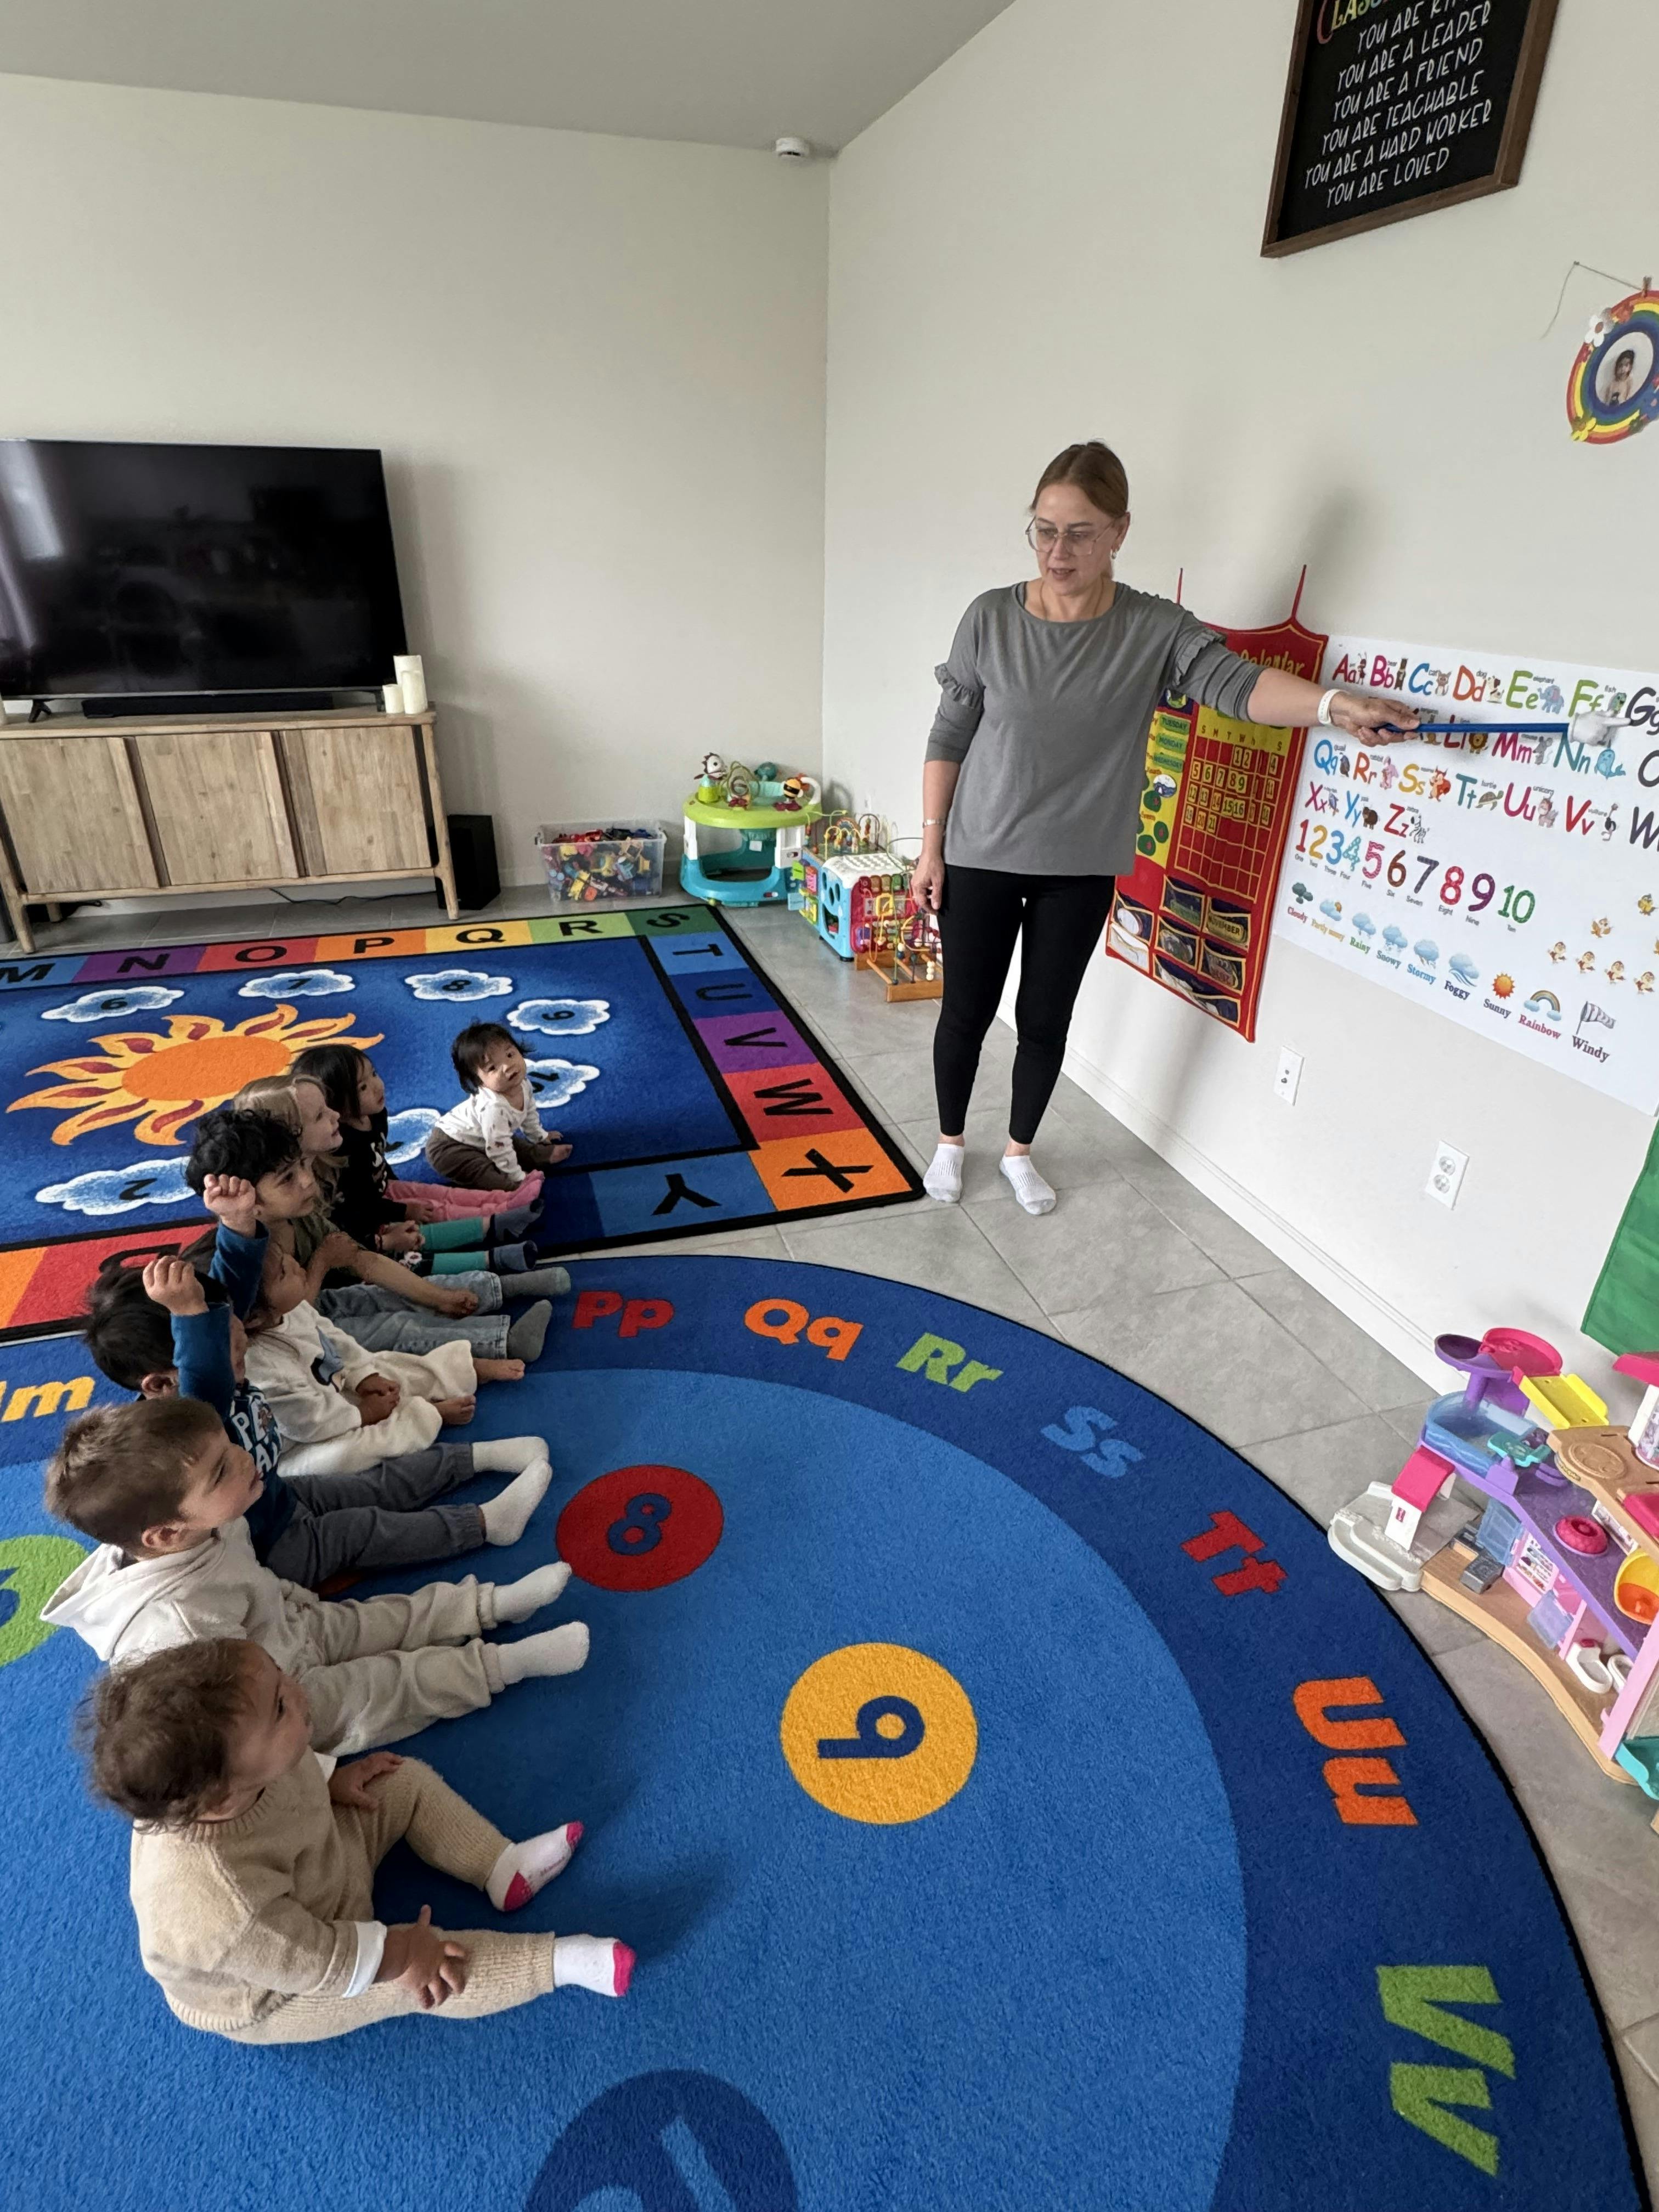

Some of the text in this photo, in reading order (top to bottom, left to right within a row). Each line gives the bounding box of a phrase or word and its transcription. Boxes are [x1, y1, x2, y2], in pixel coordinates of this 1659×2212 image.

[1338, 0, 1491, 92] YOU ARE A LEADER
[1357, 19, 1388, 54] YOU
[1391, 1, 1425, 38] ARE
[1334, 38, 1483, 122] YOU ARE A FRIEND
[1322, 70, 1485, 155] YOU ARE TEACHABLE
[1305, 99, 1492, 189] YOU ARE A HARD WORKER
[1327, 147, 1449, 208] YOU ARE LOVED
[1332, 653, 1357, 684] Aa
[1370, 654, 1394, 689] Bb
[1408, 663, 1434, 696] Cc
[1453, 664, 1487, 702] Dd
[1506, 670, 1538, 709] Ee
[1605, 685, 1616, 693] fish
[1159, 735, 1183, 749] MONDAY
[1162, 717, 1188, 729] TUESDAY
[1201, 725, 1206, 734] S
[1213, 728, 1218, 738] M
[1227, 731, 1232, 740] T
[1239, 733, 1246, 743] W
[1277, 741, 1283, 752] S
[1193, 764, 1199, 777] 5
[1205, 766, 1211, 781] 6
[1218, 770, 1224, 785] 7
[1229, 773, 1237, 787] 8
[1238, 776, 1245, 791] 9
[1235, 748, 1241, 764] 1
[1243, 752, 1250, 766] 2
[1492, 732, 1532, 764] Mm
[1553, 732, 1590, 774] Nn
[1223, 799, 1233, 813] 15
[1233, 802, 1244, 816] 16
[1305, 781, 1328, 814] Xx
[1345, 790, 1362, 828] Yy
[1384, 803, 1409, 838] Zz
[1314, 739, 1339, 776] Qq
[1353, 752, 1377, 785] Rr
[1398, 763, 1425, 795] Ss
[1455, 773, 1477, 809] Tt
[1481, 780, 1497, 789] turtle
[1504, 782, 1536, 821] Uu
[1533, 786, 1555, 795] unicorn
[1566, 795, 1595, 836] Vv
[1296, 819, 1535, 924] 1 2 3 4 5 6 7 8 9 10
[1386, 889, 1396, 898] Six
[1406, 895, 1423, 907] Seven
[1438, 905, 1453, 916] Eight
[1465, 915, 1480, 926] Nine
[0, 912, 691, 983] M N O P Q R S
[673, 944, 723, 957] T
[101, 997, 128, 1011] 6
[286, 977, 314, 990] 7
[442, 979, 472, 992] 8
[696, 983, 754, 1002] U
[1288, 906, 1308, 923] Cloudy
[1350, 936, 1370, 954] Rainy
[1376, 950, 1402, 969] Snowy
[1407, 964, 1436, 985] Stormy
[1444, 980, 1470, 1000] Foggy
[1483, 998, 1512, 1019] Sunny
[1517, 1014, 1562, 1040] Rainbow
[1572, 1035, 1610, 1063] Windy
[723, 1027, 788, 1048] V
[752, 1078, 834, 1116] W
[119, 1178, 157, 1201] 2
[652, 1173, 722, 1217] Y
[781, 1148, 875, 1194] X
[572, 1290, 675, 1339] Pp
[743, 1297, 864, 1362] Qq
[895, 1331, 1004, 1393] Rr
[0, 1375, 96, 1422] m
[1041, 1404, 1146, 1480] Ss
[607, 1492, 672, 1555] 8
[1180, 1510, 1288, 1597] Tt
[817, 1695, 926, 1759] 9
[1293, 1675, 1419, 1826] Uu
[1375, 1964, 1516, 2177] Vv
